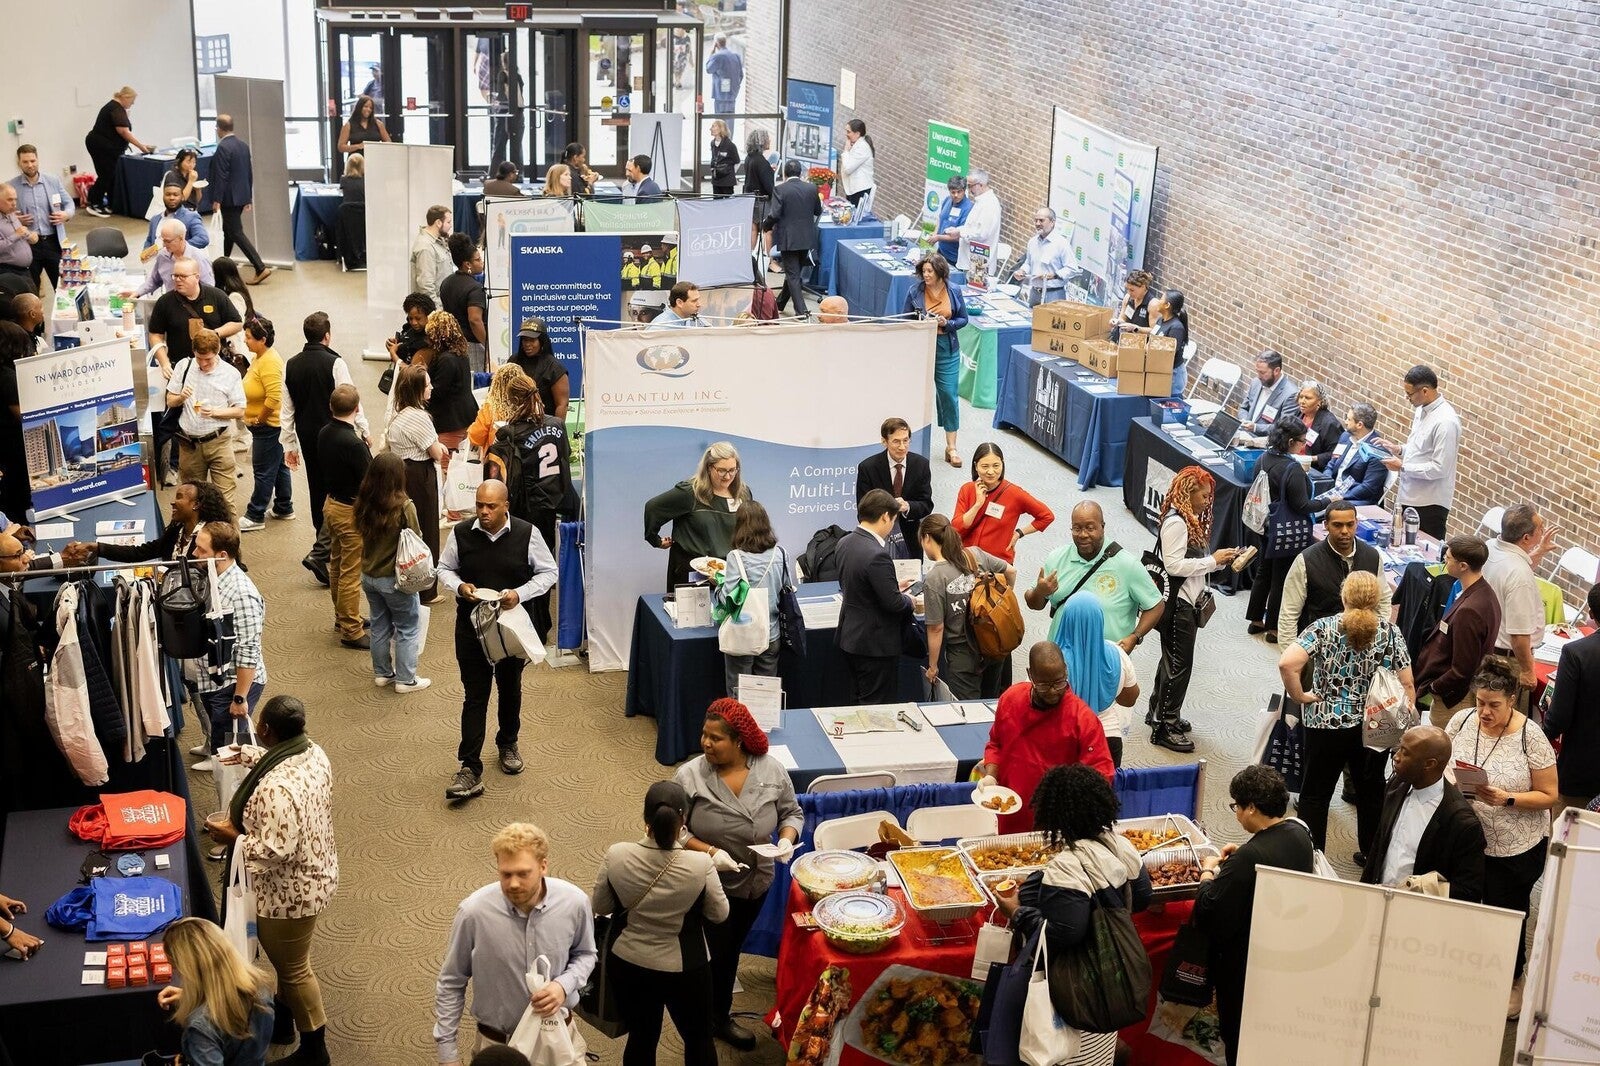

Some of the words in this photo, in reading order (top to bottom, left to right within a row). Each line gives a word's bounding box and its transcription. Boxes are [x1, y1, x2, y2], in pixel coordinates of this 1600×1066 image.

[510, 6, 527, 18] EXIT
[932, 132, 963, 147] UNIVERSAL
[936, 146, 957, 158] WASTE
[930, 157, 962, 173] RECYCLING
[550, 282, 592, 290] committed
[522, 305, 555, 313] respects
[570, 303, 599, 312] people,
[546, 315, 571, 323] strong
[35, 375, 46, 384] TN
[48, 368, 73, 380] WARD
[75, 359, 116, 374] COMPANY
[53, 376, 102, 392] BUILDERS
[601, 391, 685, 404] QUANTUM
[694, 390, 728, 400] INC.
[524, 426, 563, 449] ENDLESS
[538, 443, 560, 478] 2
[790, 467, 800, 477] A
[804, 466, 858, 477] Compre
[71, 480, 107, 493] tnward.com
[788, 501, 840, 514] Services
